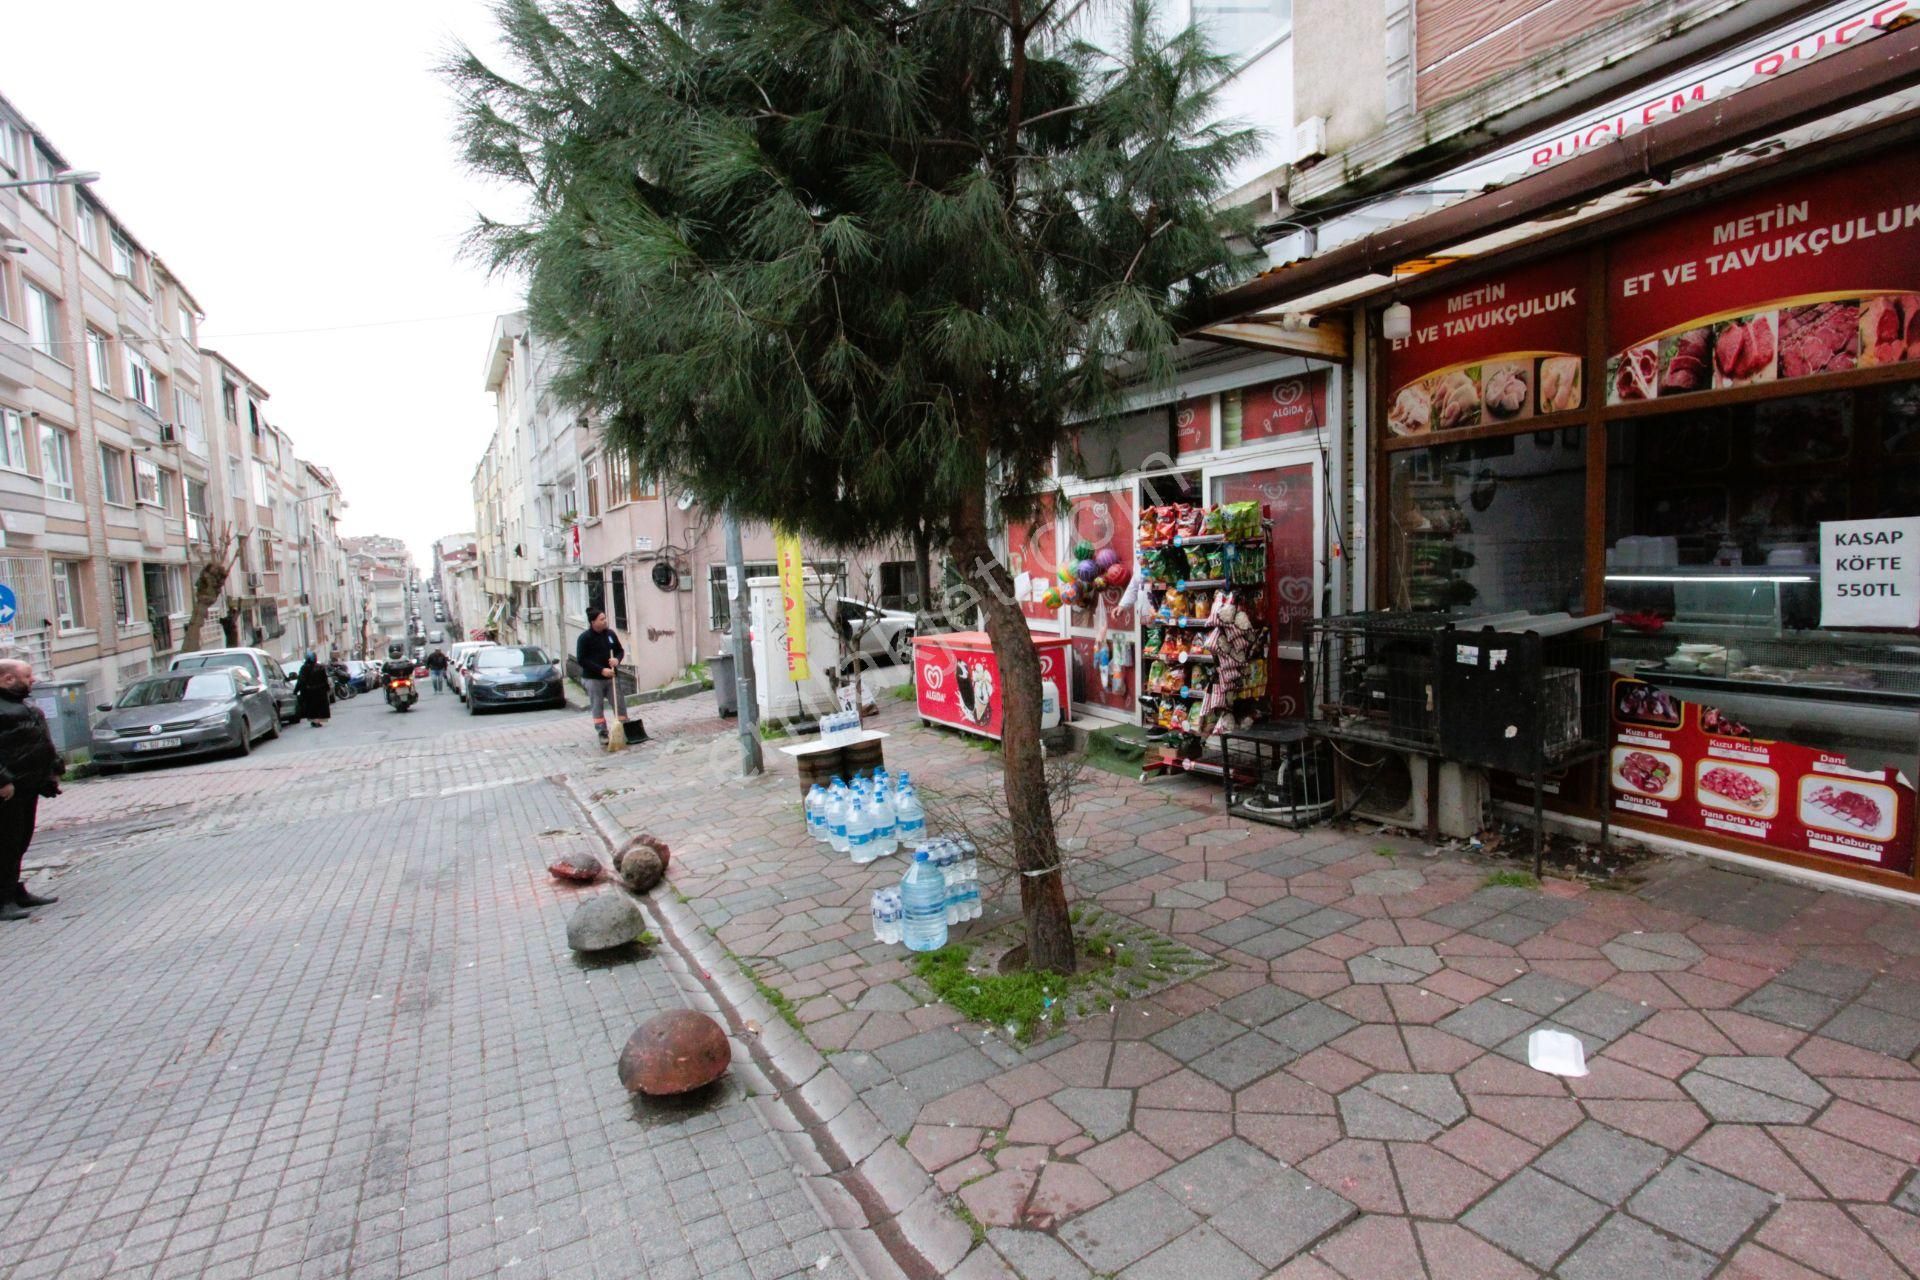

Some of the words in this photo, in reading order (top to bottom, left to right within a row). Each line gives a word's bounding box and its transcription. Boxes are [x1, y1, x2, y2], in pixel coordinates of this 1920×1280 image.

[1623, 272, 1654, 297] ET
[1662, 262, 1697, 287] VE
[1706, 203, 1920, 276] TAVUKÇULUK
[1416, 325, 1439, 344] VE
[1443, 288, 1577, 338] TAVUKÇULUK
[1835, 531, 1903, 546] KASAP
[1836, 555, 1901, 571] KÖFTE
[1837, 583, 1900, 597] 550TL
[1625, 728, 1646, 738] Kuzu
[1648, 731, 1663, 740] But
[1709, 739, 1733, 749] Kuzu
[1623, 794, 1644, 804] Dana
[1701, 809, 1724, 820] Dana
[1726, 814, 1746, 824] Orta
[1806, 829, 1834, 842] Dana
[1836, 836, 1884, 852] Kaburga
